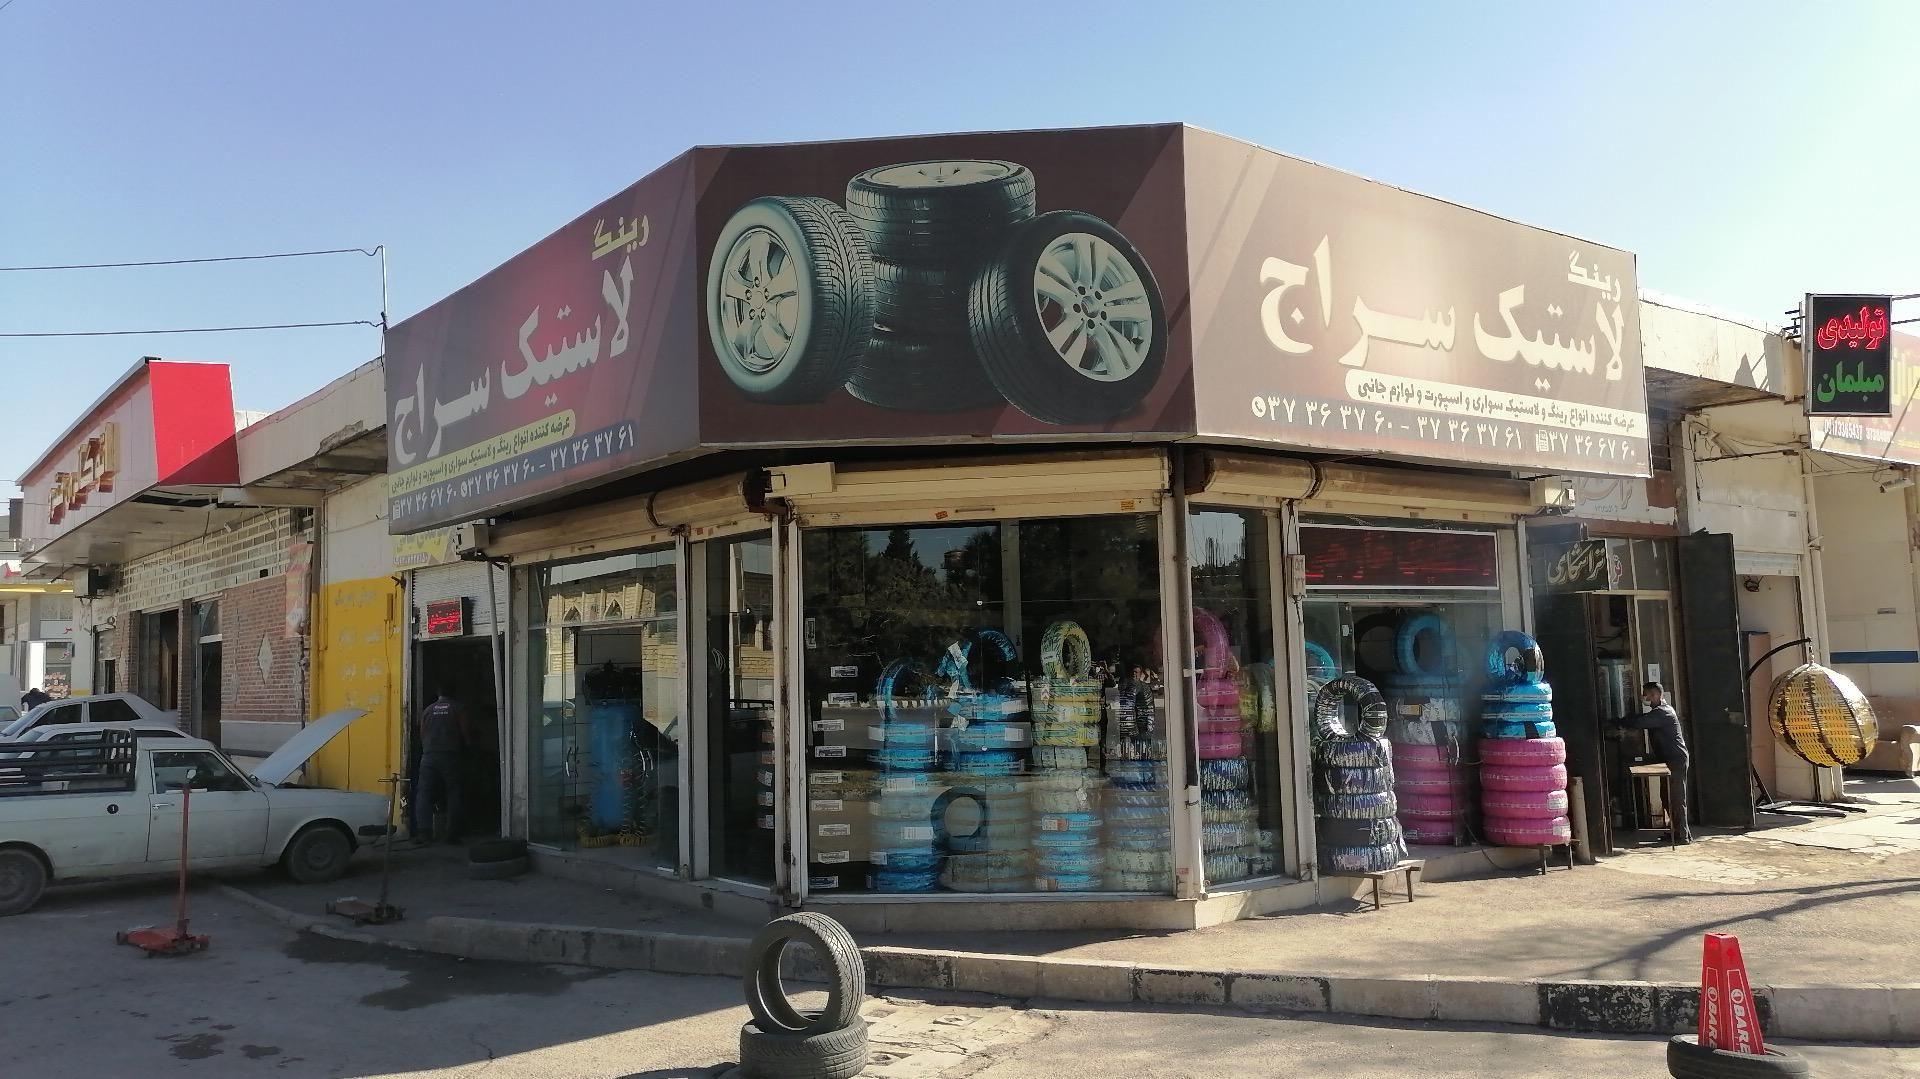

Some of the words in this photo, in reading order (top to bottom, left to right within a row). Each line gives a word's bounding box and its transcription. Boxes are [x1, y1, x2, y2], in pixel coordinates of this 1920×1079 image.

[591, 214, 650, 262] رینگ
[1567, 249, 1621, 303] رینگ
[1259, 233, 1457, 368] سراج
[501, 255, 634, 406] لاستیک
[1473, 284, 1625, 391] لاستیک
[1817, 306, 1887, 350] تولیدی
[1358, 378, 1387, 399] جانبی
[1389, 382, 1415, 403] لوازم
[1424, 390, 1463, 411] اسپورت
[1817, 360, 1885, 403] مبلمان
[394, 361, 491, 465] سراج
[1472, 395, 1503, 413] سواری
[1548, 402, 1568, 425] رینگ
[1570, 409, 1589, 428] انواع
